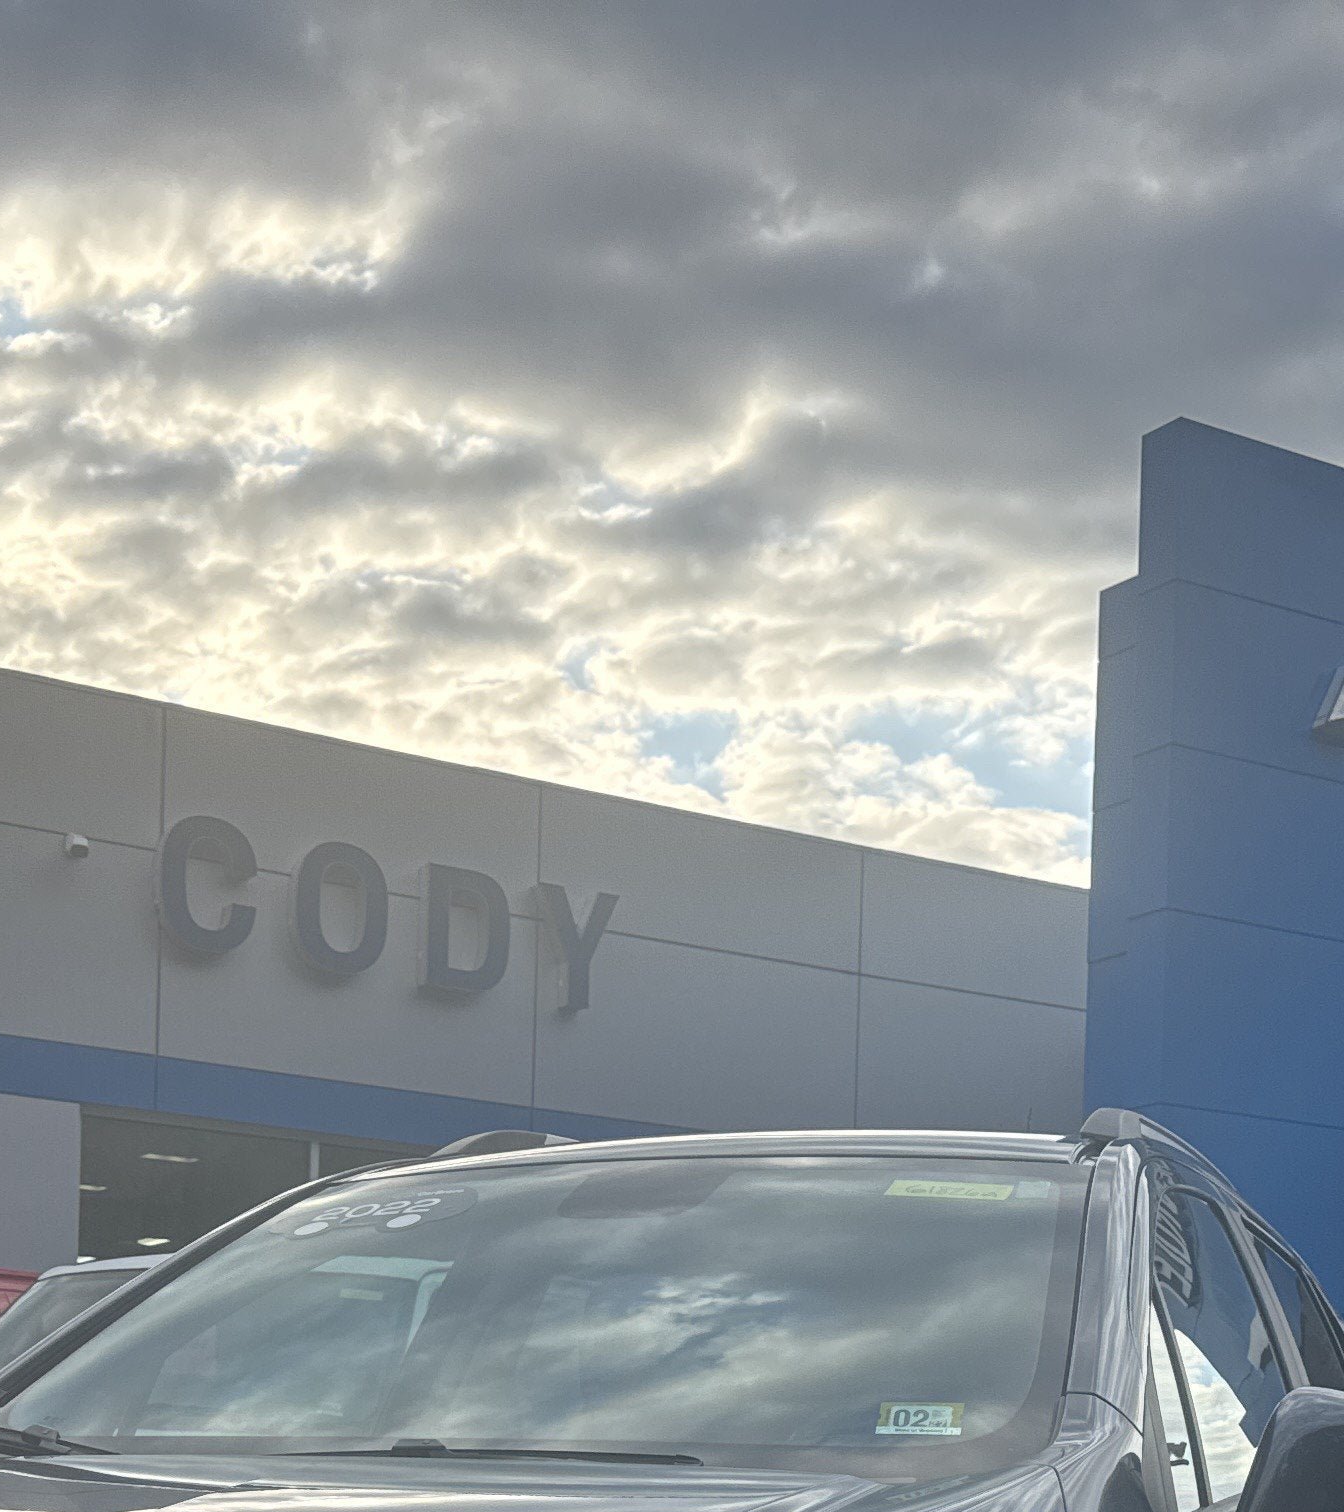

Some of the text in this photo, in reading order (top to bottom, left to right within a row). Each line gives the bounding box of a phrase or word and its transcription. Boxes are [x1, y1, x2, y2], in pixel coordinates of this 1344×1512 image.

[156, 815, 620, 1012] CODY
[311, 1198, 442, 1222] 2022
[892, 1408, 930, 1427] 02
